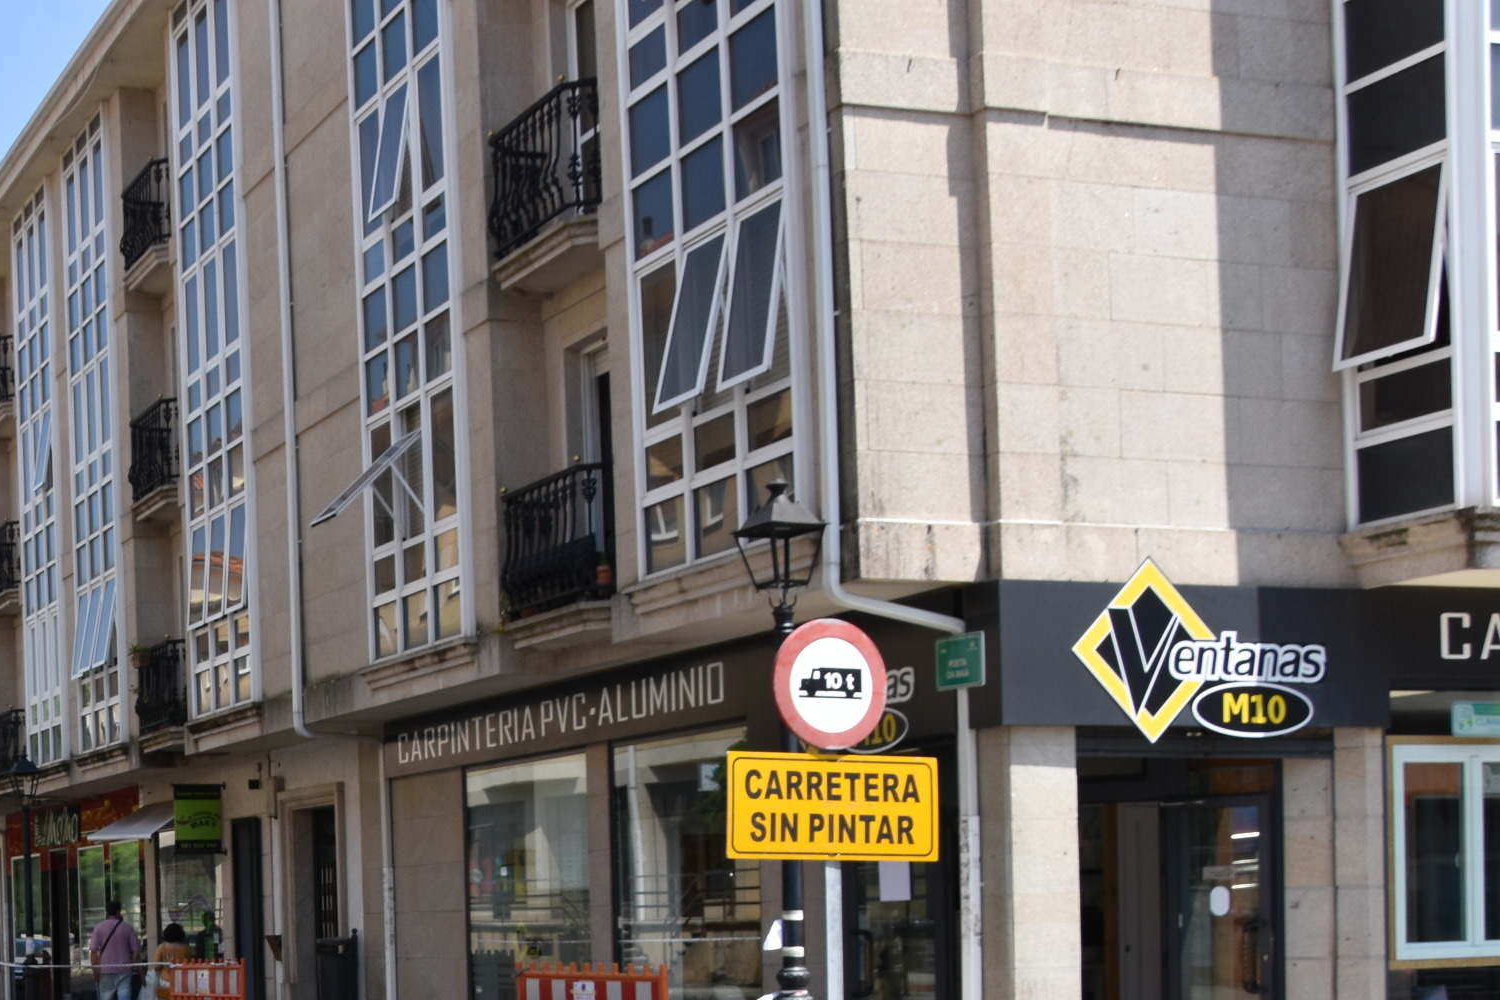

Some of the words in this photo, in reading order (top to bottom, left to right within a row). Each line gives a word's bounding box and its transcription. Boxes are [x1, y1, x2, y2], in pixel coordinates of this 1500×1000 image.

[1107, 607, 1326, 716] Ventanas
[824, 672, 843, 690] 10
[846, 673, 855, 690] t
[1222, 692, 1287, 725] M10
[397, 705, 535, 764] CARPINTERIA
[745, 769, 920, 803] CARRETERA
[750, 811, 798, 842] SIN
[809, 813, 915, 844] PINTAR
